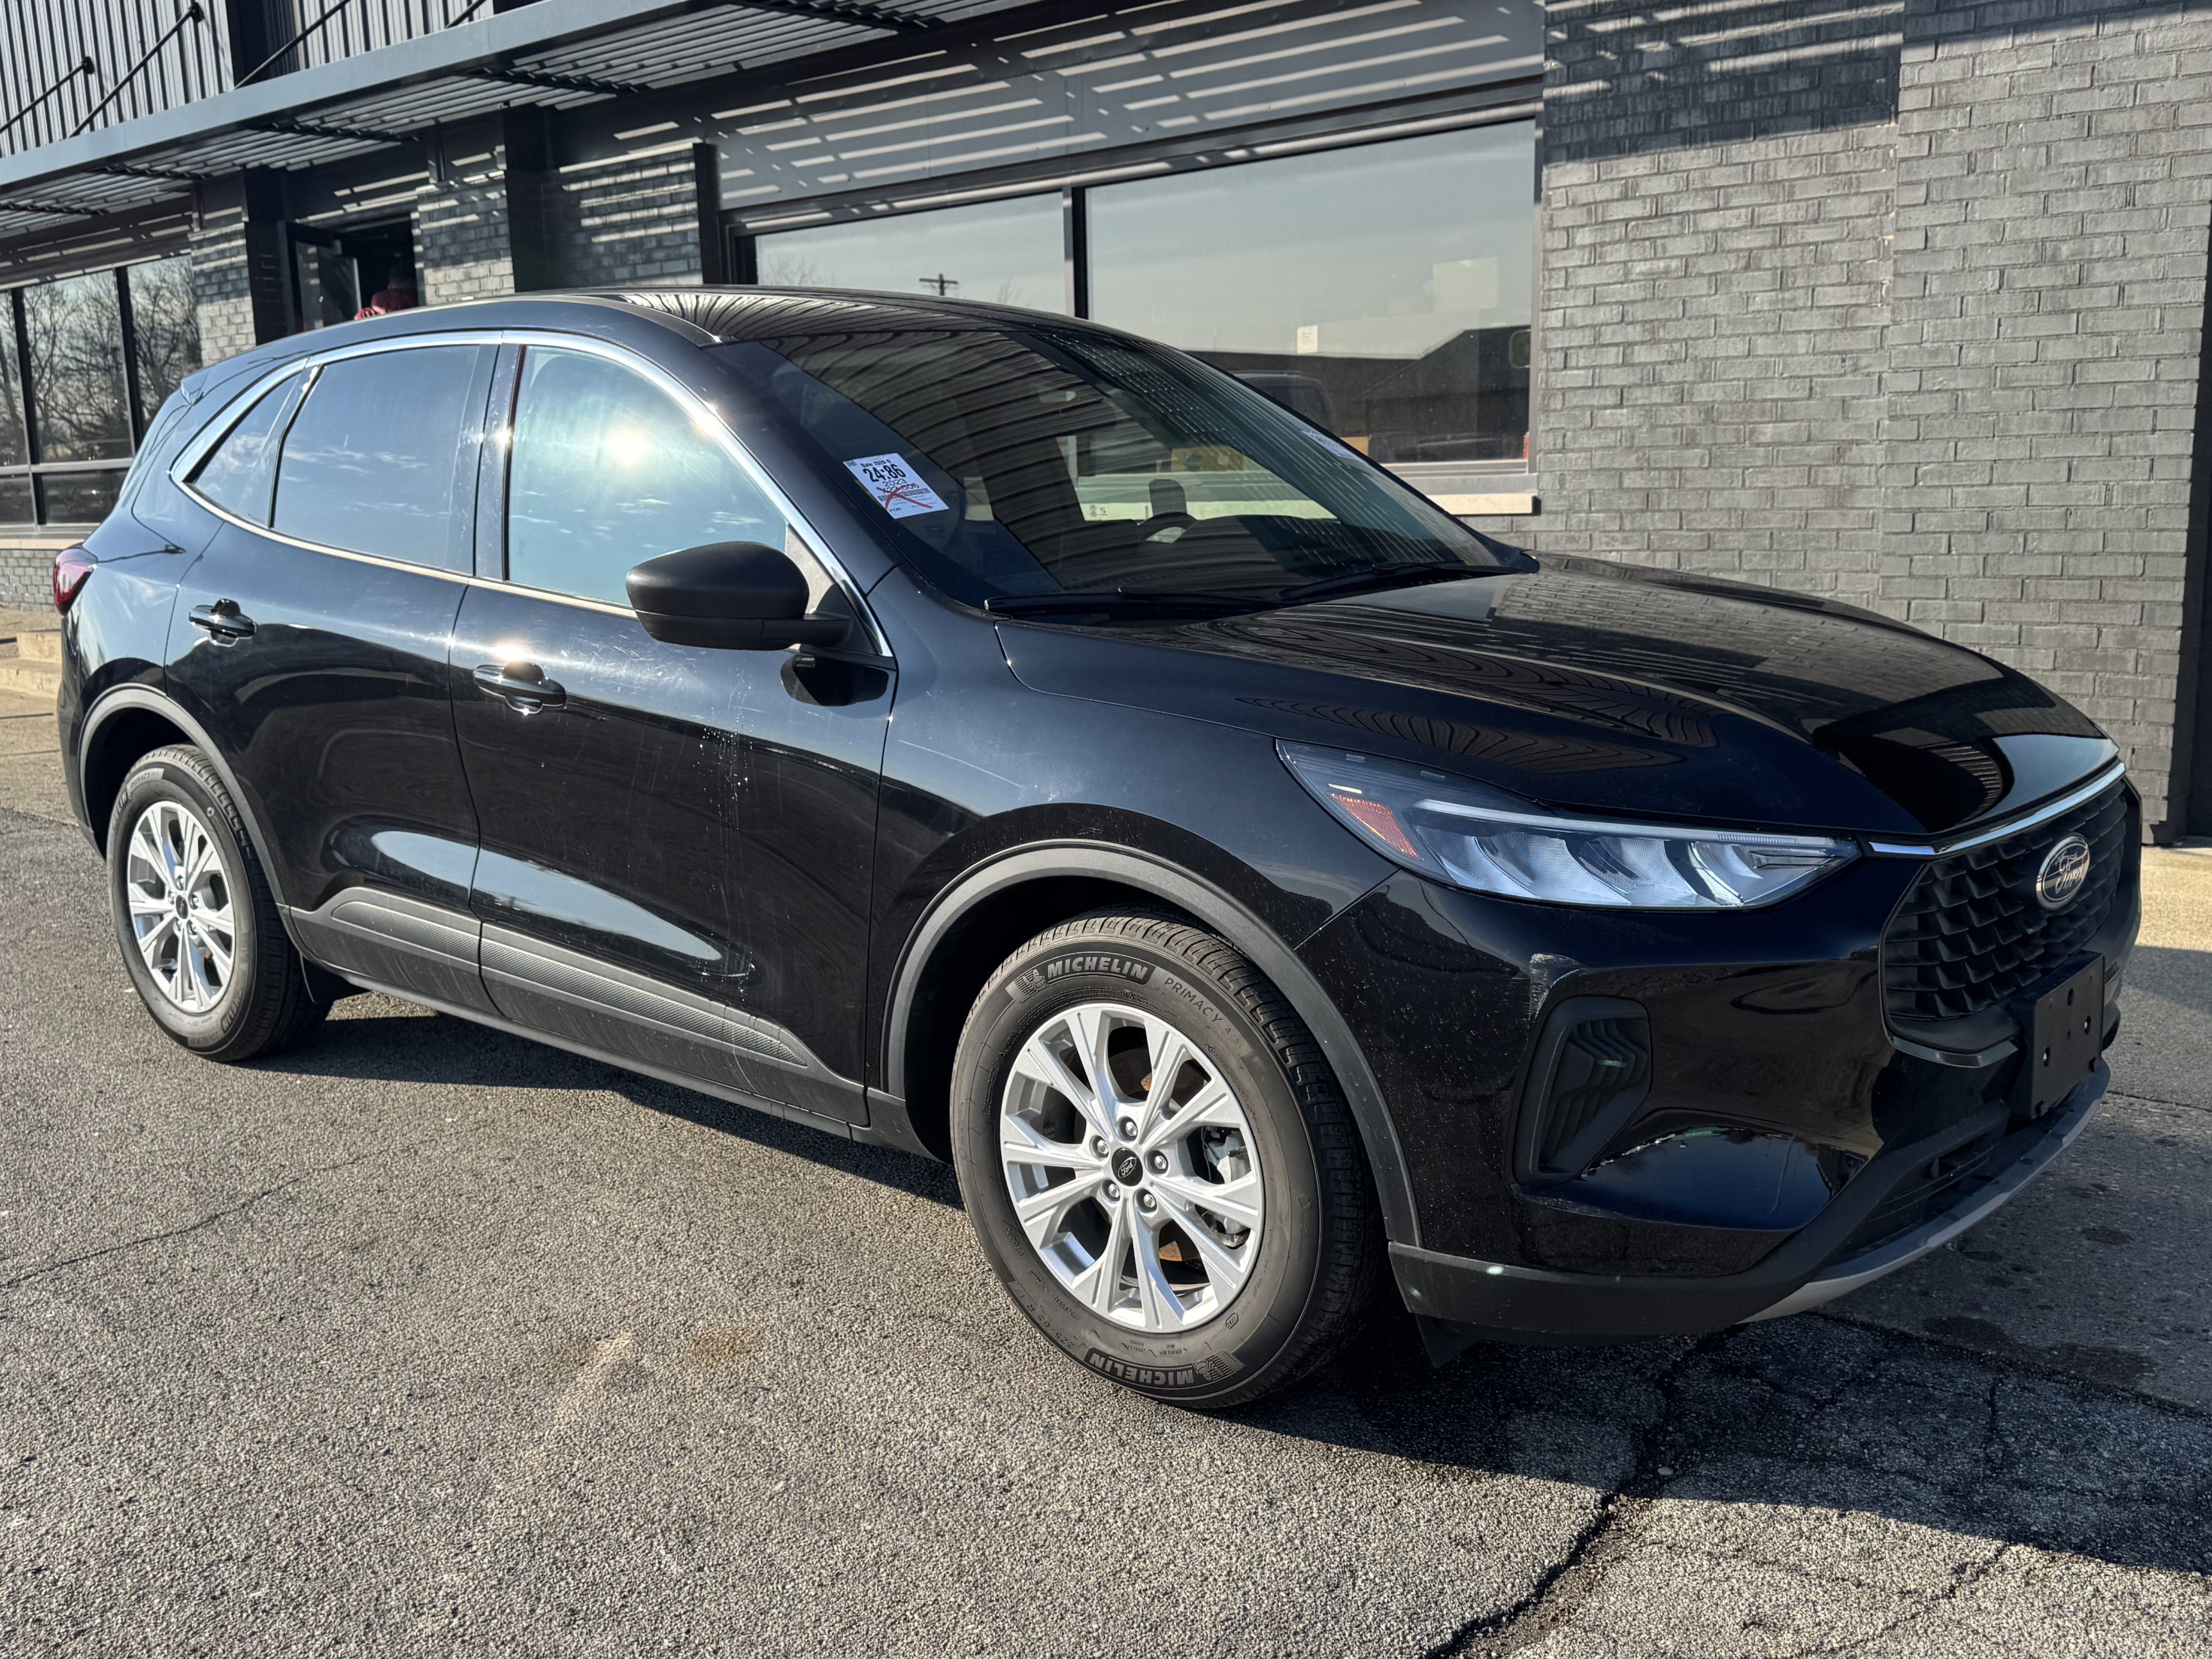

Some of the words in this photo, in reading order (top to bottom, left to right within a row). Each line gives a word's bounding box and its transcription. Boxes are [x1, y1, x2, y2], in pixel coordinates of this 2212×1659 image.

[863, 464, 906, 482] 24:86
[883, 479, 907, 487] 2023
[2053, 850, 2084, 894] Ford
[1048, 957, 1148, 980] MICHELIN
[1164, 978, 1222, 1022] PRIMACY
[1225, 1028, 1240, 1045] A/S
[1089, 1353, 1195, 1385] MICHELIN
